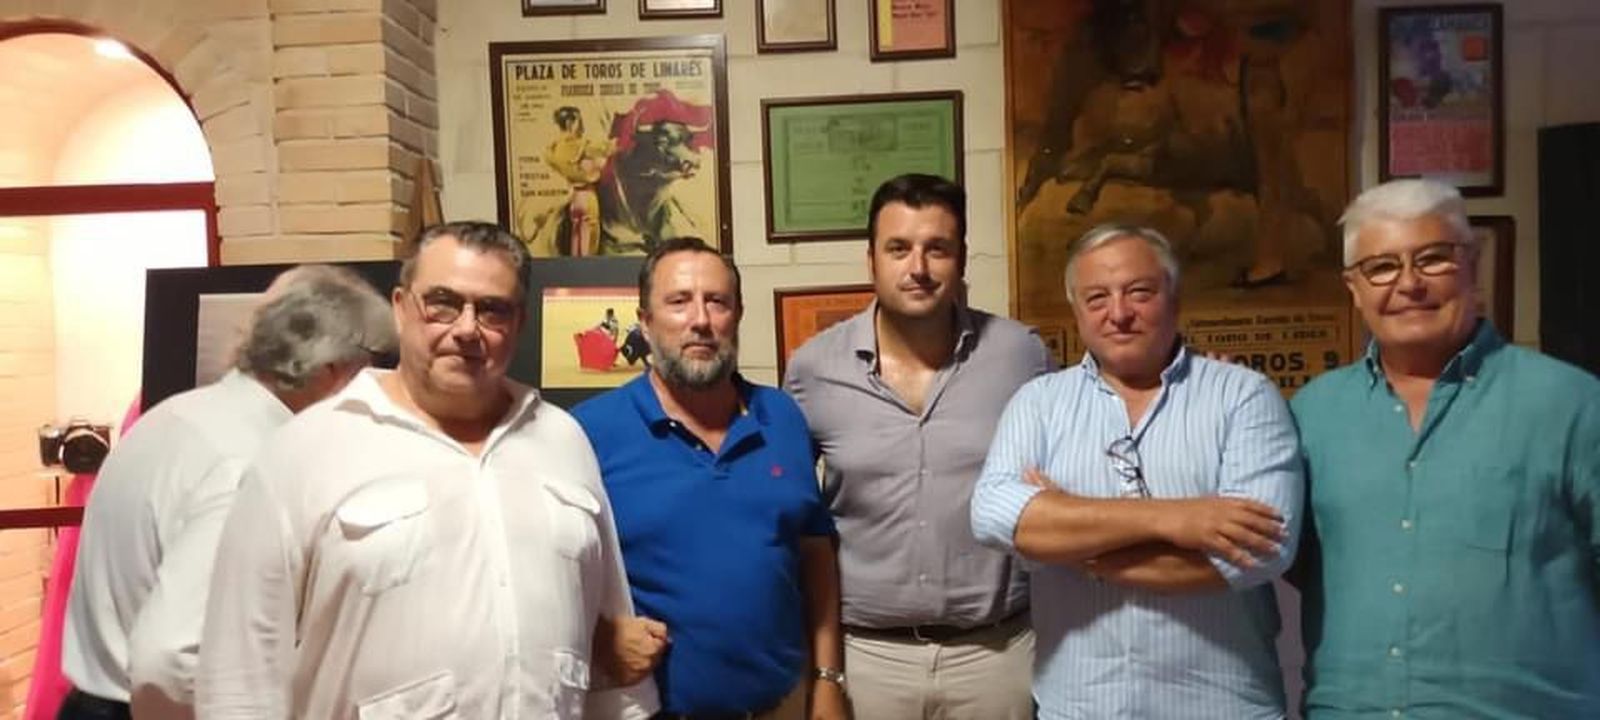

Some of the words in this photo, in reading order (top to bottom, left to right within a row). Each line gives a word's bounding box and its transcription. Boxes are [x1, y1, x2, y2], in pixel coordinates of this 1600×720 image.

[515, 64, 554, 80] PLAZA
[561, 64, 577, 79] DE
[584, 63, 622, 79] TOROS
[630, 62, 647, 78] DE
[653, 60, 703, 77] LINARES
